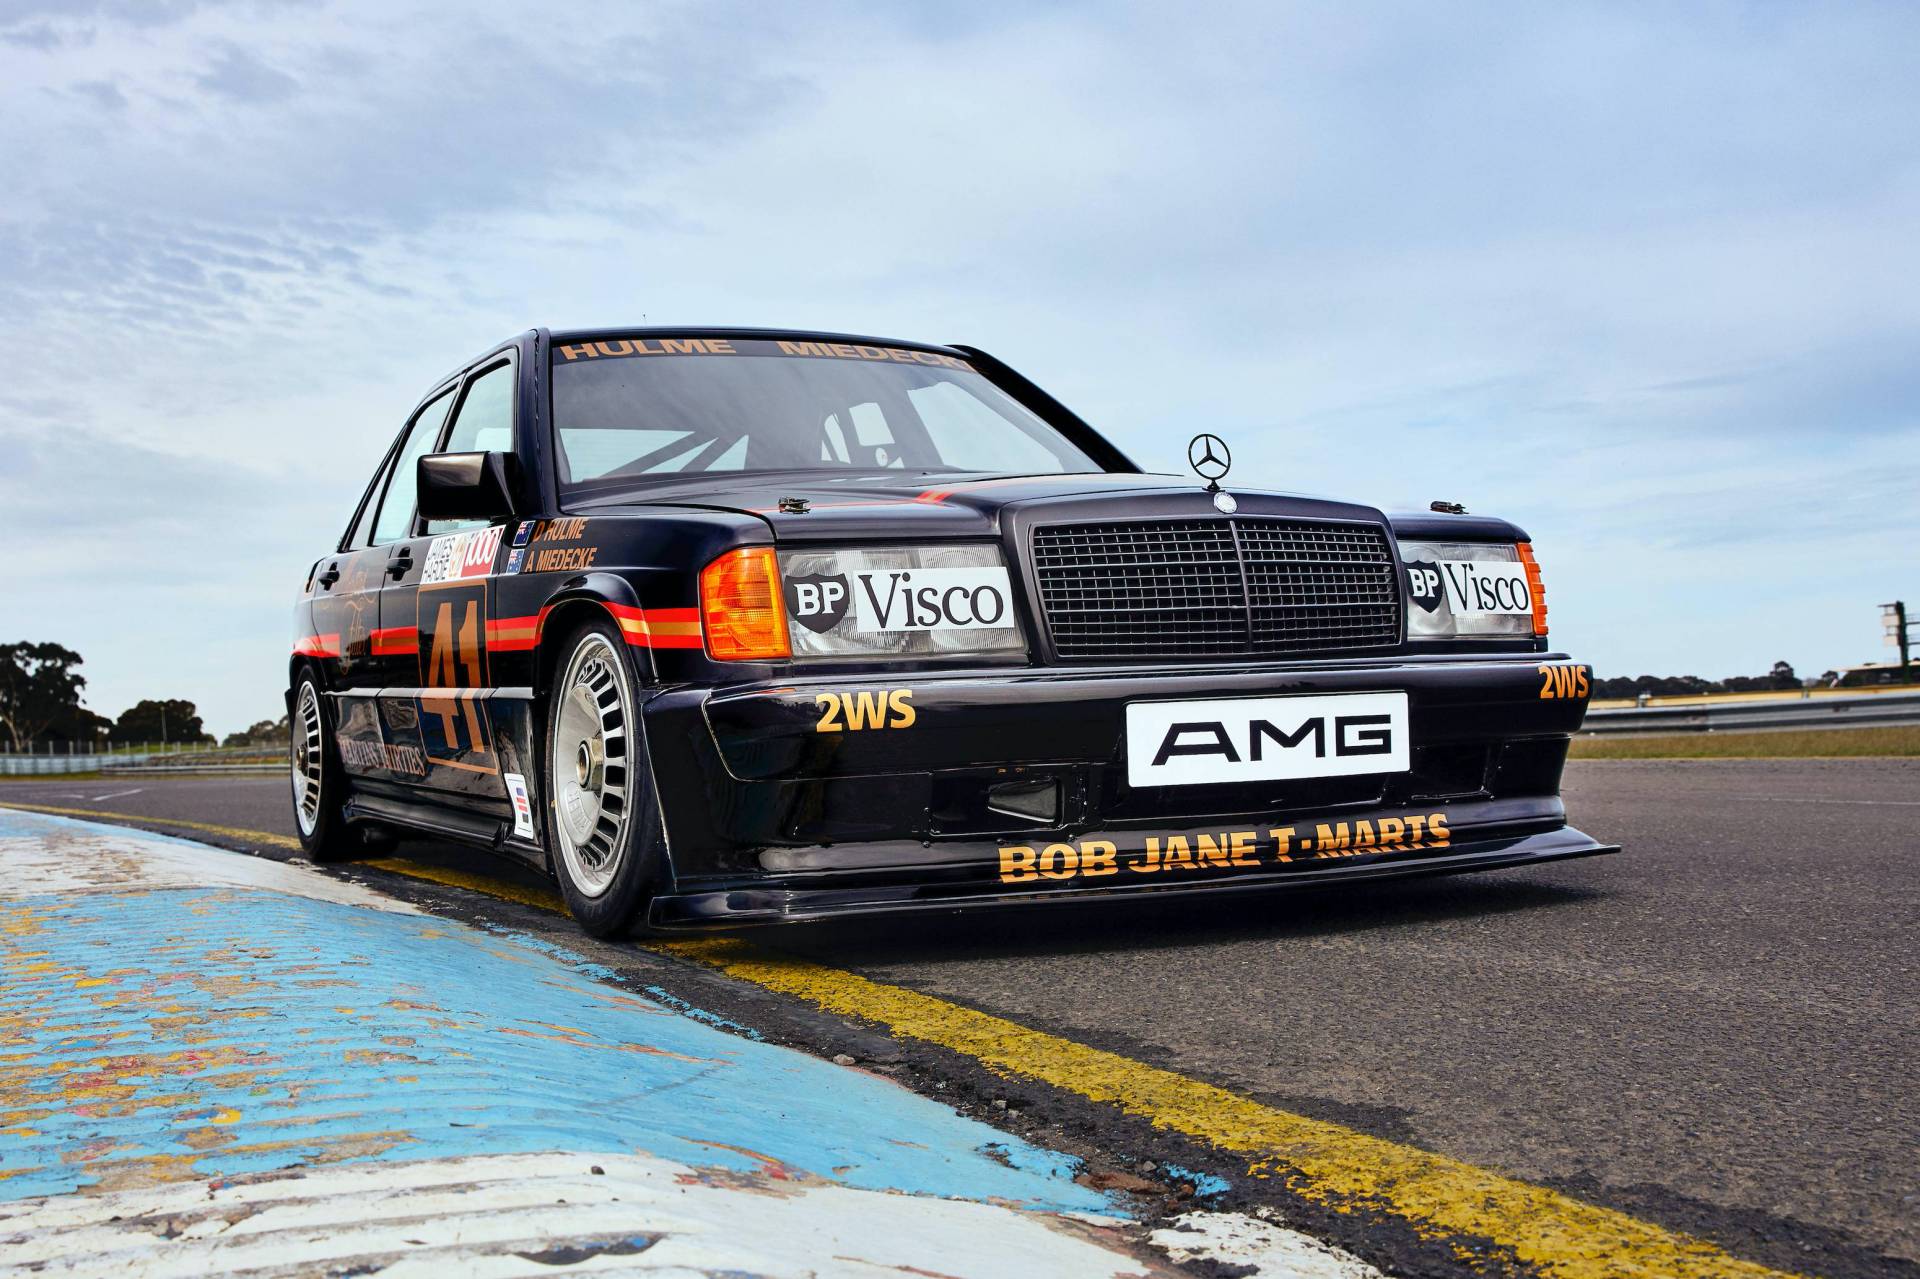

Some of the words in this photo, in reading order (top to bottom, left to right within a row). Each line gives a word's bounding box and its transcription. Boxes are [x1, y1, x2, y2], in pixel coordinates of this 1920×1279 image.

[560, 339, 736, 360] HULME
[776, 341, 978, 373] MIEDECK
[465, 526, 501, 566] 1000
[532, 521, 545, 542] D
[544, 517, 588, 541] HULME
[525, 550, 535, 572] A
[536, 547, 597, 571] MIEDECKE
[793, 581, 845, 616] BP
[858, 572, 1004, 628] Visco
[1407, 569, 1439, 597] BP
[1444, 563, 1529, 611] Visco
[420, 600, 484, 752] 41
[1538, 665, 1589, 699] 2WS
[815, 689, 916, 733] 2WS
[1151, 714, 1391, 766] AMG
[998, 840, 1119, 883] BOB
[1128, 831, 1261, 873] JANE
